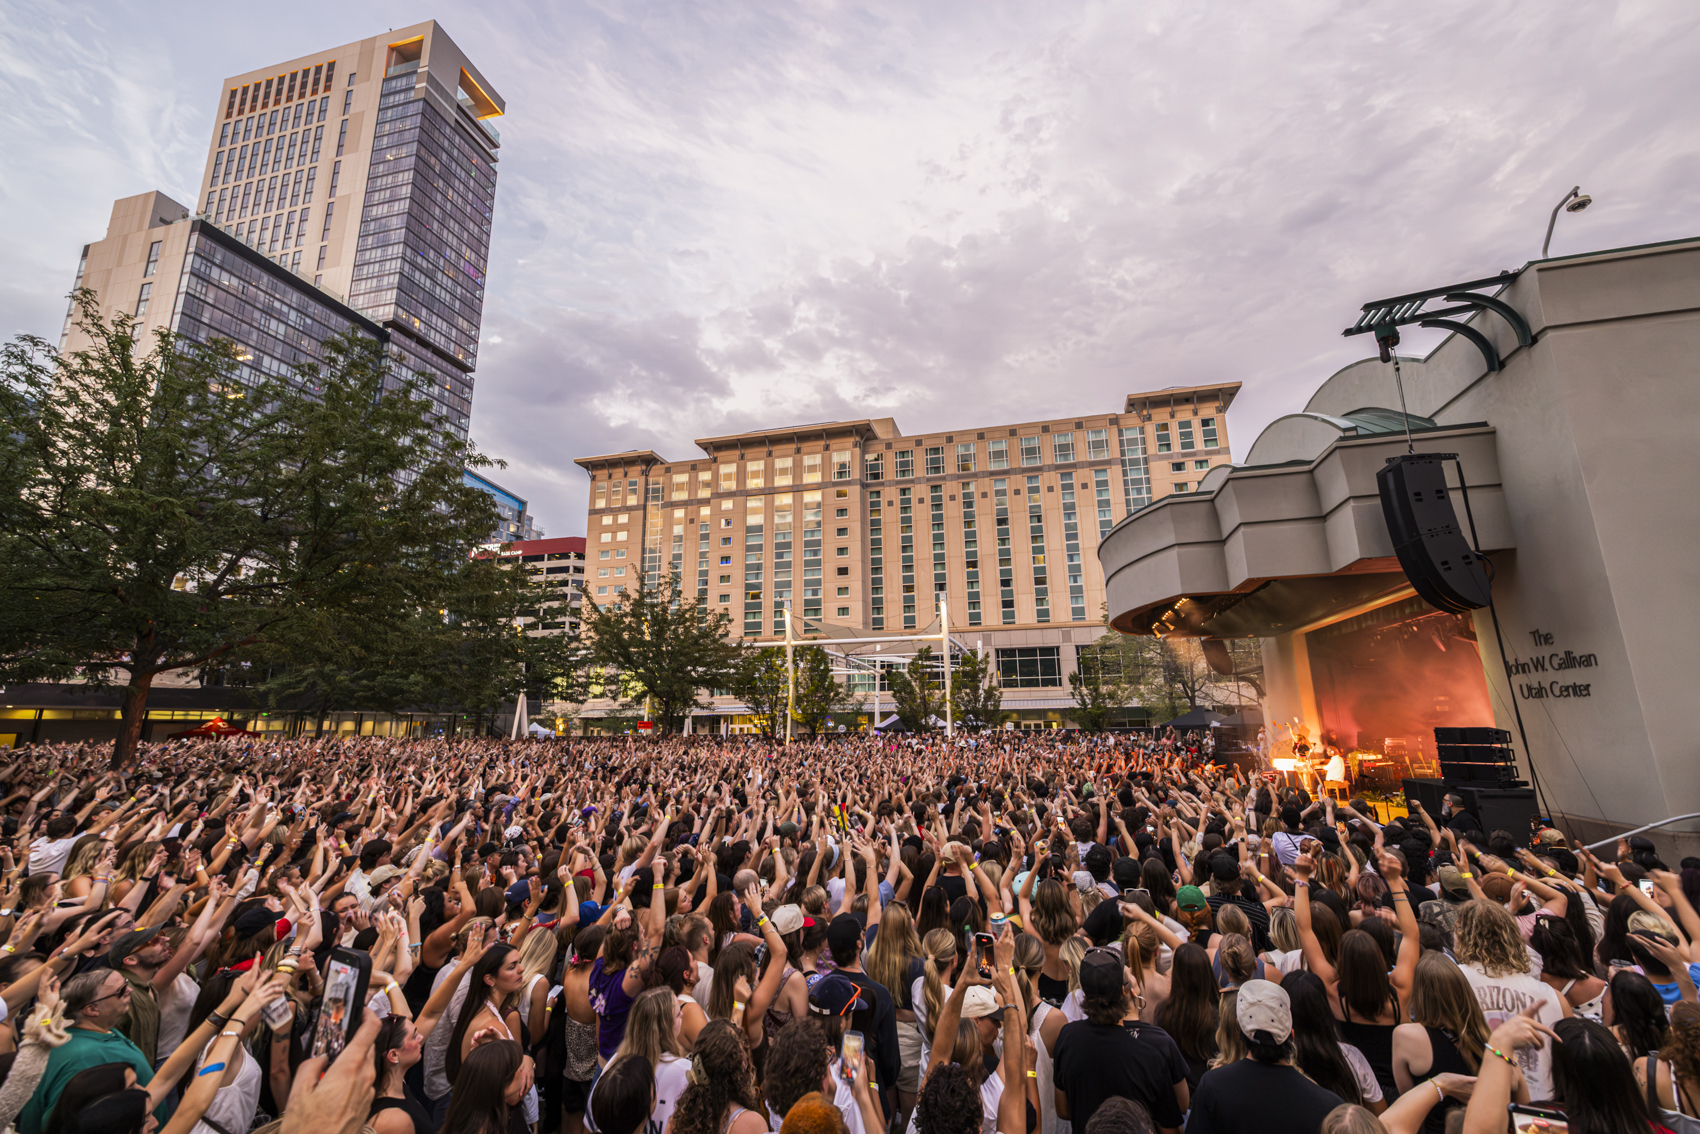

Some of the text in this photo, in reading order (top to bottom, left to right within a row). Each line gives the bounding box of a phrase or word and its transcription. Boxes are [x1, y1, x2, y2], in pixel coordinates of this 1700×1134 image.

[1529, 629, 1554, 647] The
[1506, 650, 1598, 678] John W. Gallivan
[1519, 681, 1591, 700] Utah Center
[1476, 985, 1542, 1023] RIZON
